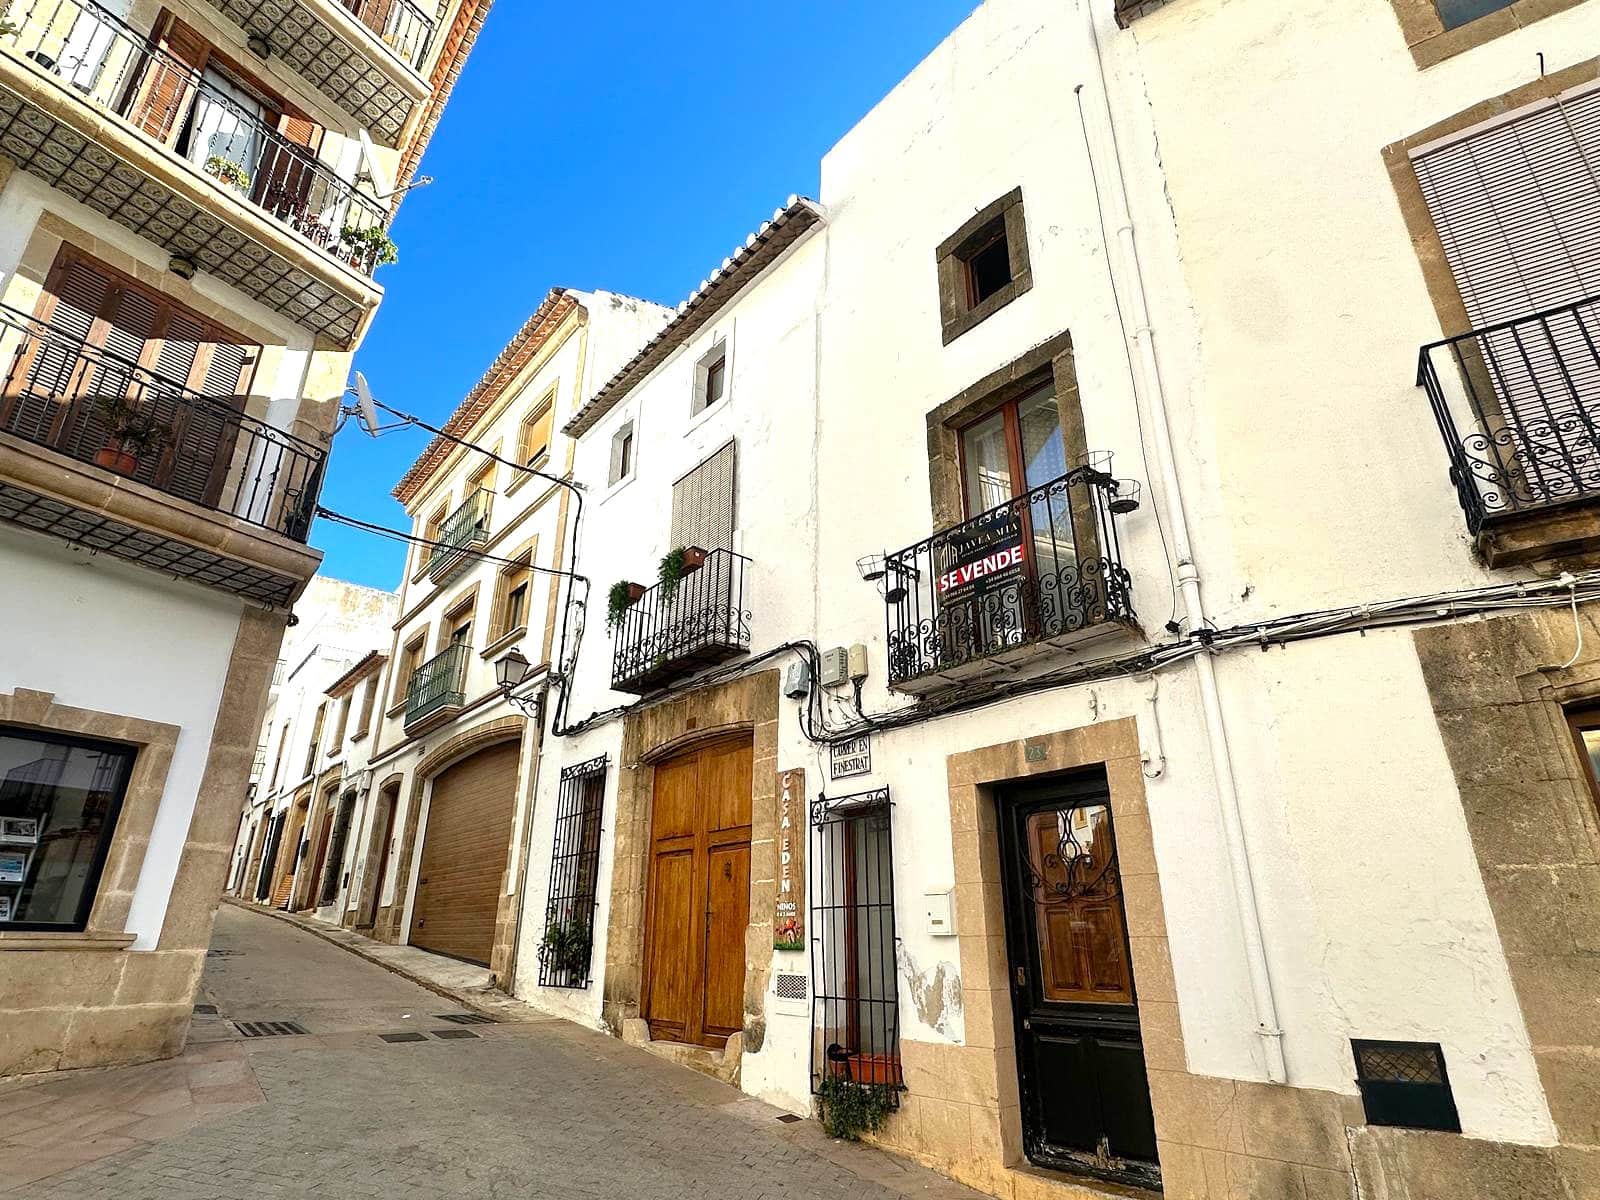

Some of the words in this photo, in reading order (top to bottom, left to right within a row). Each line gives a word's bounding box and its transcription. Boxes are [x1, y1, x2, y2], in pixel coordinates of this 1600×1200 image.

[940, 569, 959, 592] SE
[960, 545, 1023, 582] VENDE
[833, 755, 869, 775] FINESTRAT
[781, 773, 792, 829] CASA
[781, 838, 791, 893] EDEN
